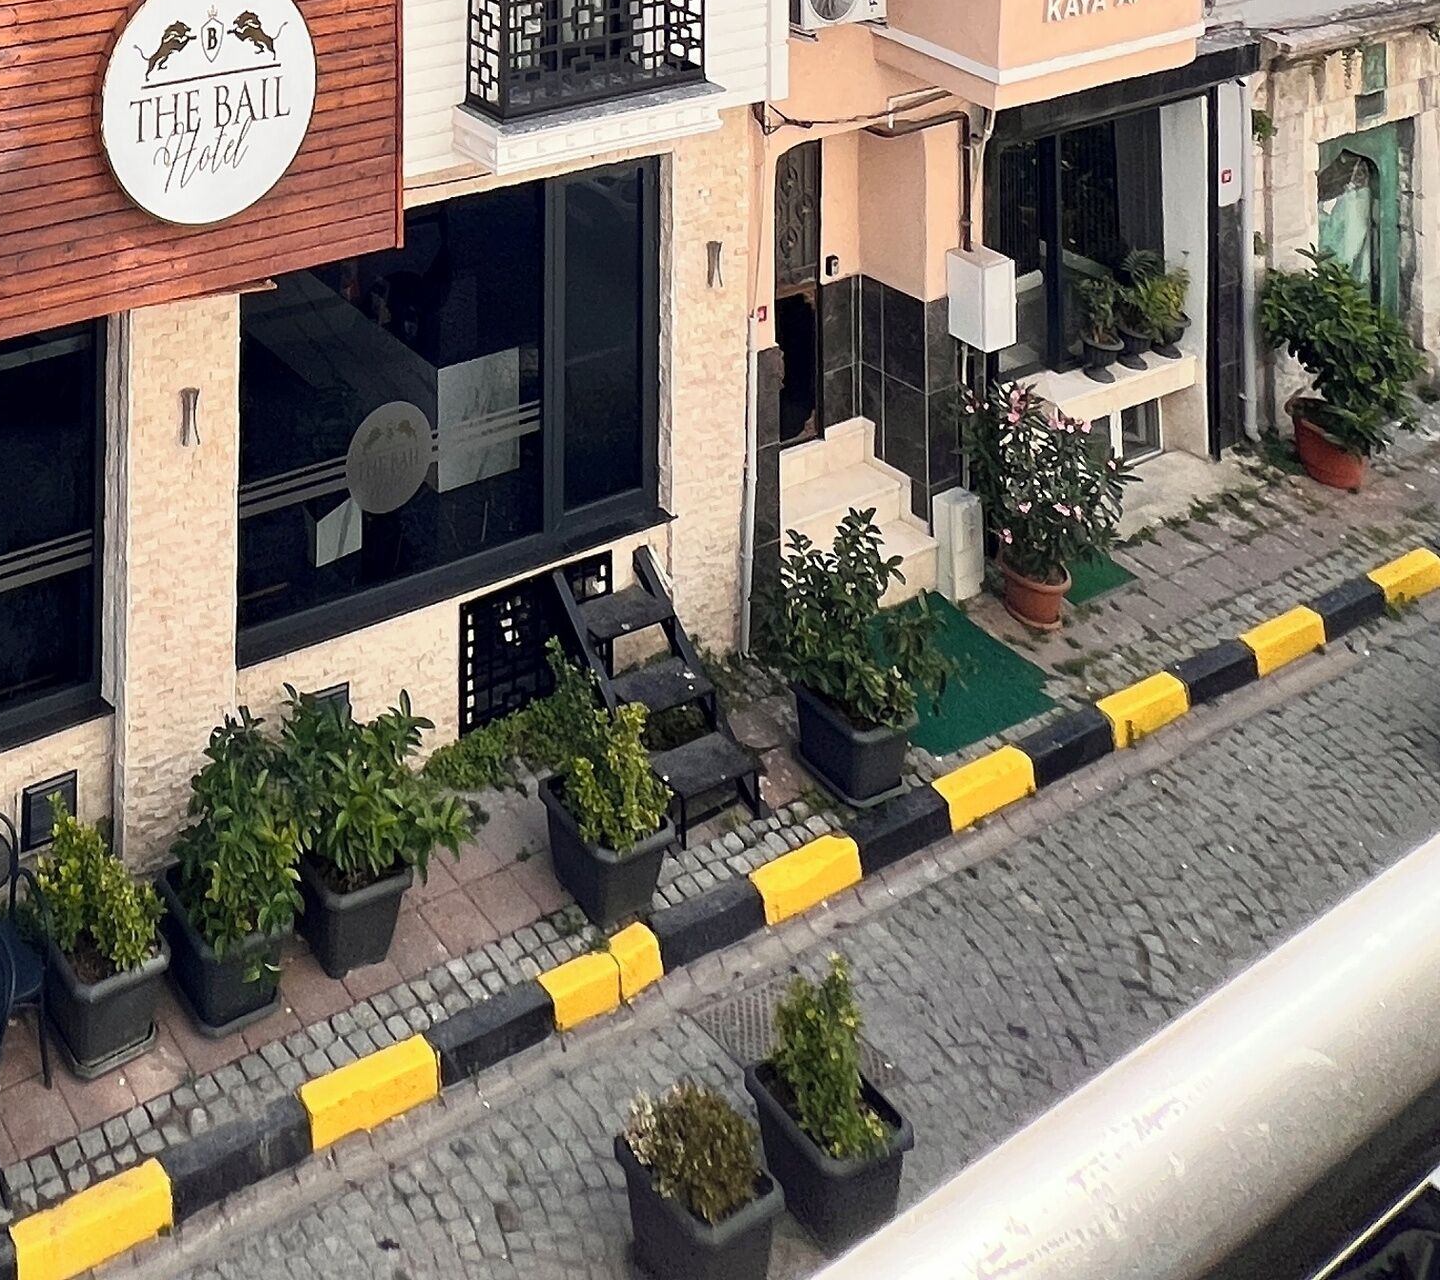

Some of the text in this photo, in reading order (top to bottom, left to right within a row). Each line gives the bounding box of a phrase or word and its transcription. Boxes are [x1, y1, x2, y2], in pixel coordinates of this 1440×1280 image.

[206, 26, 218, 51] B
[129, 76, 291, 144] THE BAIL
[153, 117, 253, 194] Hotel
